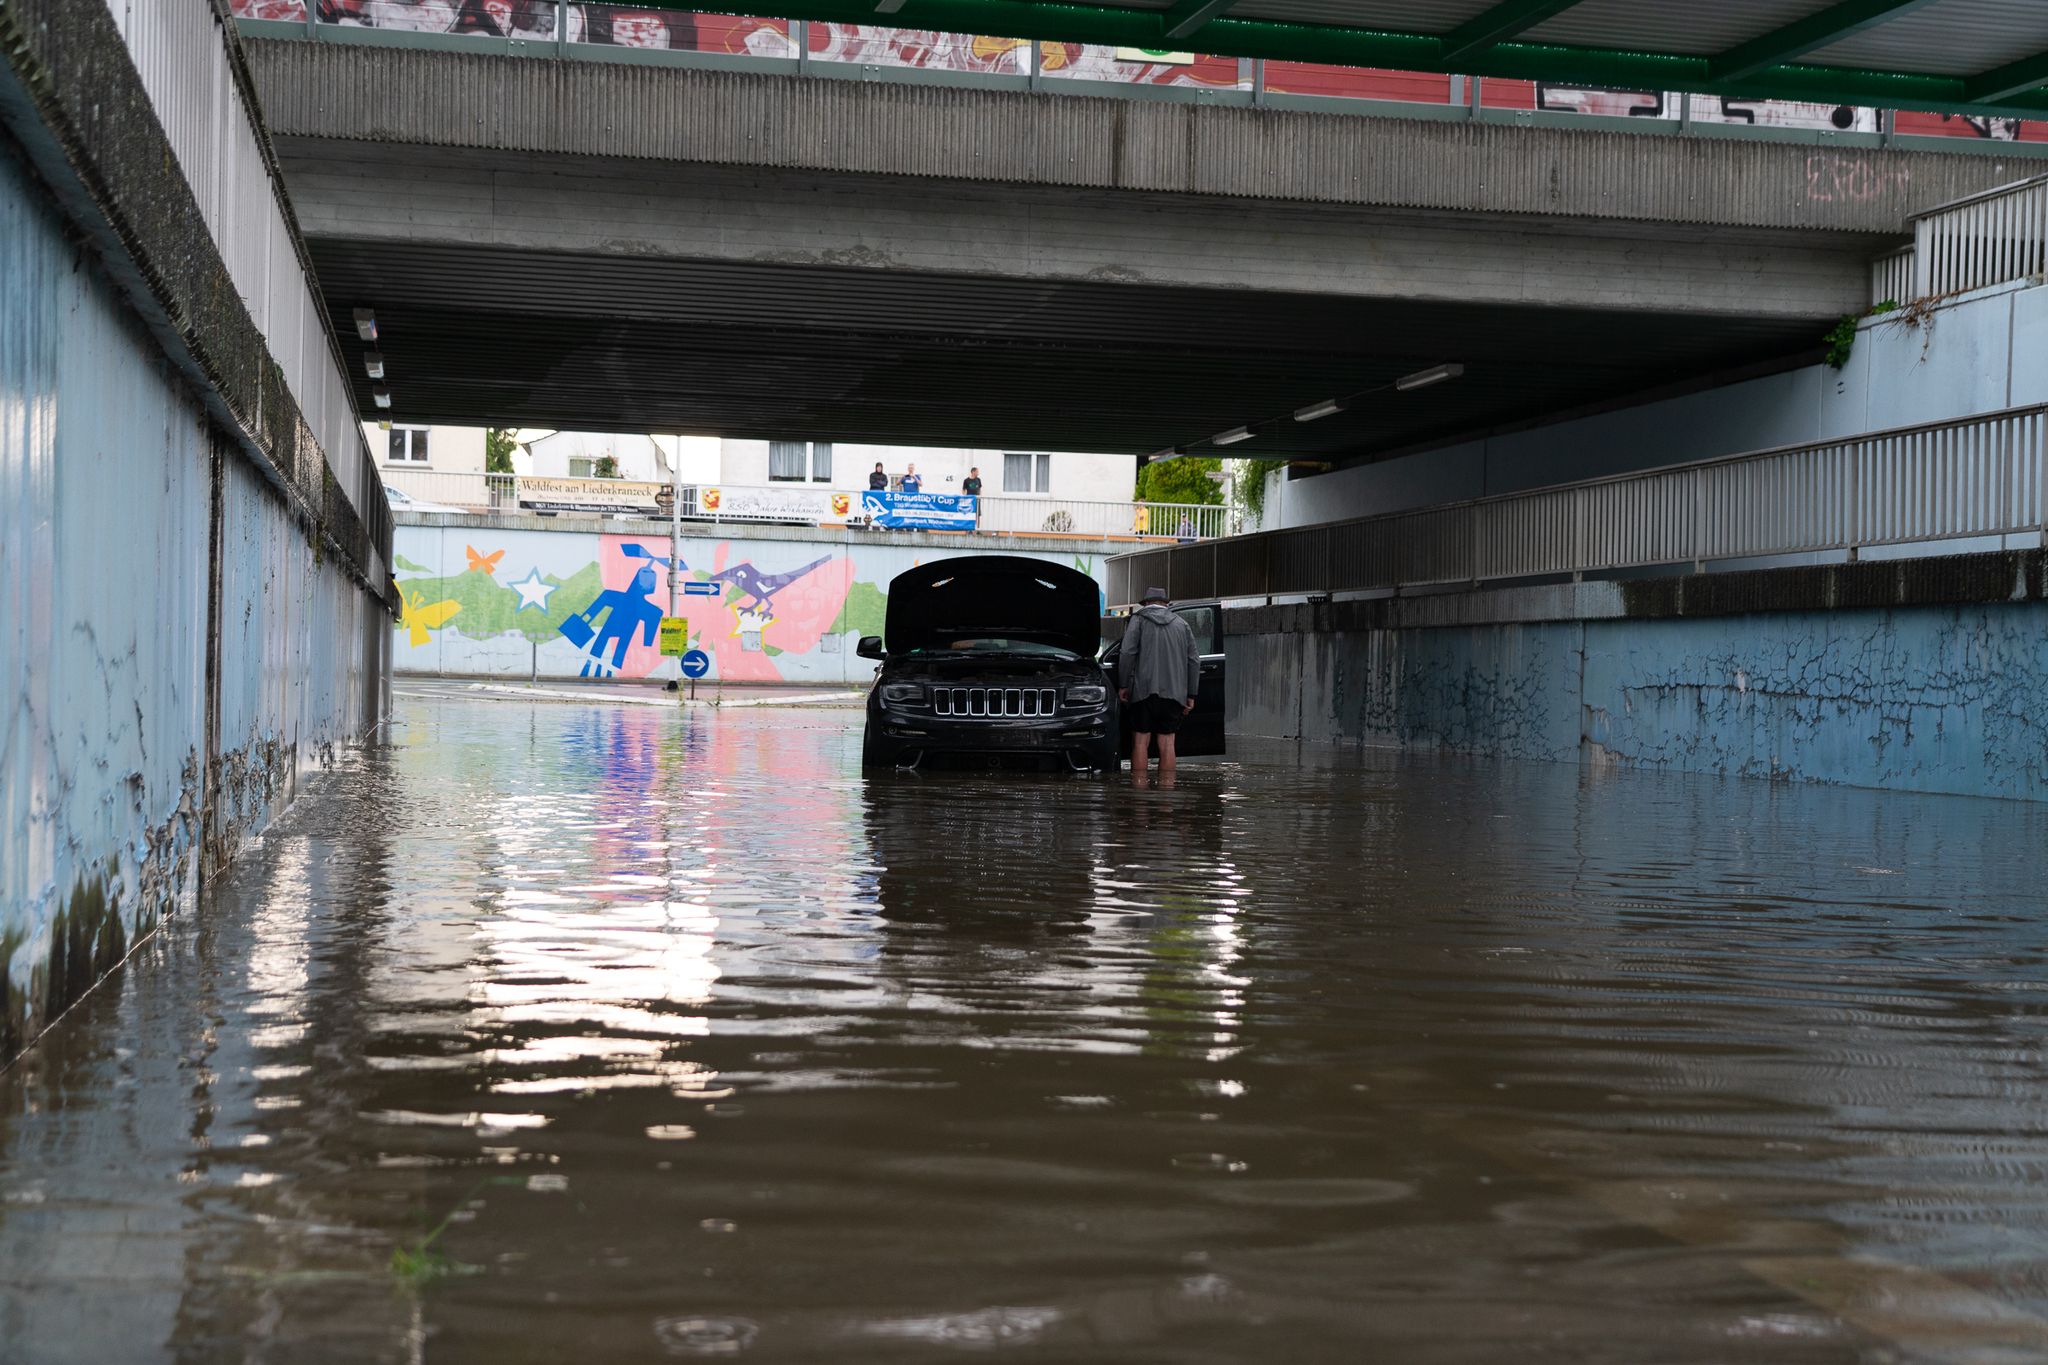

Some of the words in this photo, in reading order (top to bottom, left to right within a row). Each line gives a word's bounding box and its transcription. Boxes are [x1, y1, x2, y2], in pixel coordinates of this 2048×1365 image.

[522, 480, 562, 492] Waldfest
[565, 484, 579, 493] am
[582, 483, 652, 496] Liederkranzeck
[885, 493, 893, 502] 2.
[937, 496, 955, 505] Cup
[727, 502, 750, 511] 850
[750, 503, 778, 514] Jahre
[780, 503, 824, 515] Wixhausen
